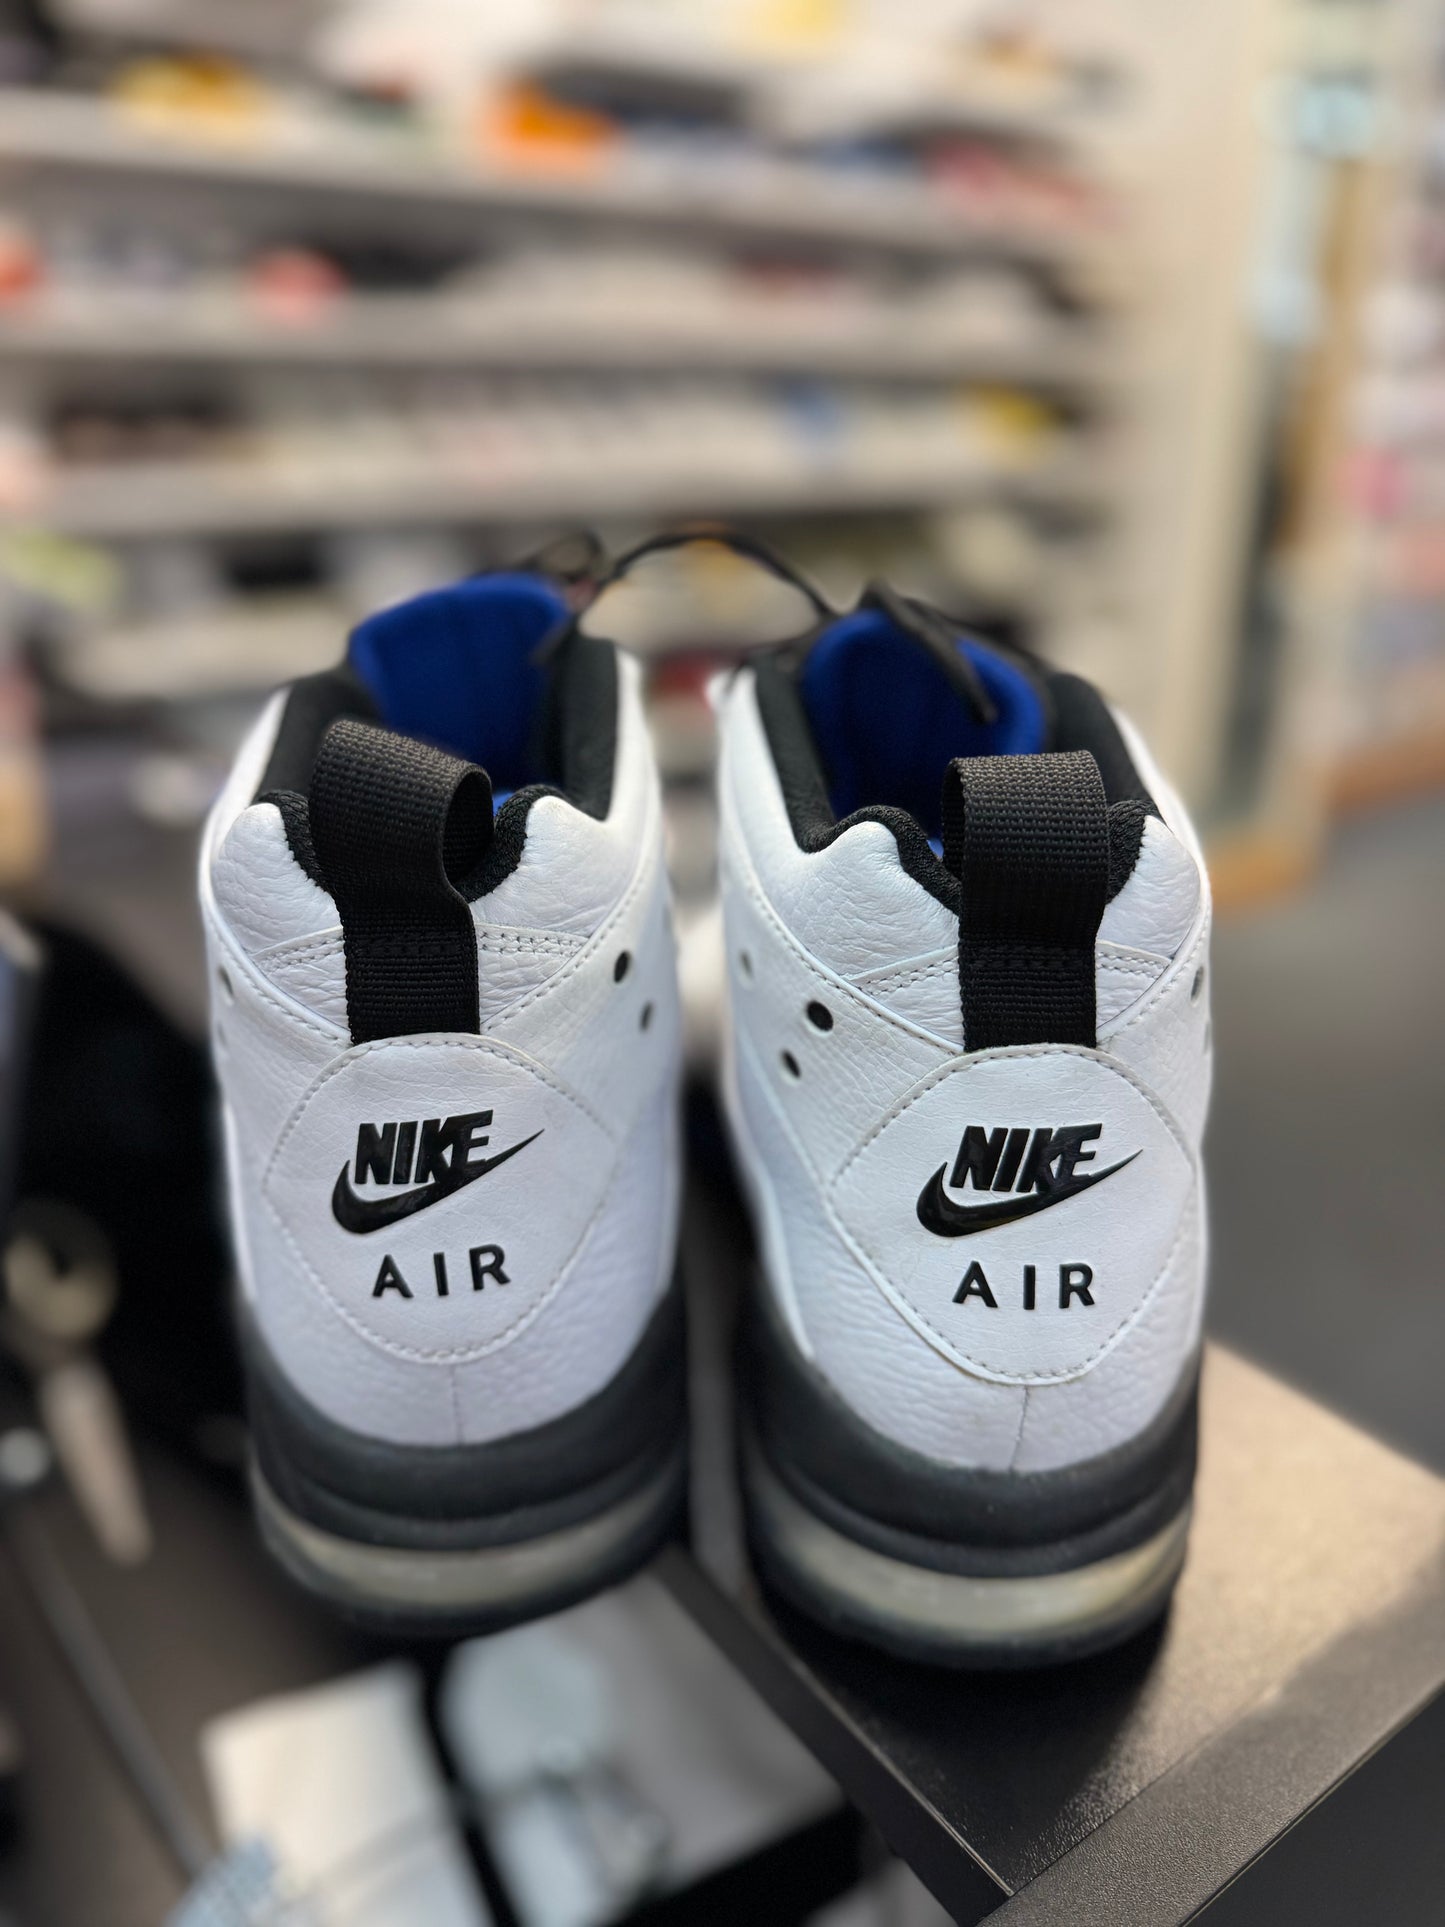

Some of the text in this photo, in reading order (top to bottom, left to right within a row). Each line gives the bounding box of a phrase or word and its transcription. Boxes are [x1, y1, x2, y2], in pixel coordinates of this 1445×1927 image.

[354, 1109, 494, 1185] NIKE
[949, 1123, 1103, 1193] NIKE
[372, 1244, 511, 1299] AIR
[952, 1260, 1095, 1310] AIR
